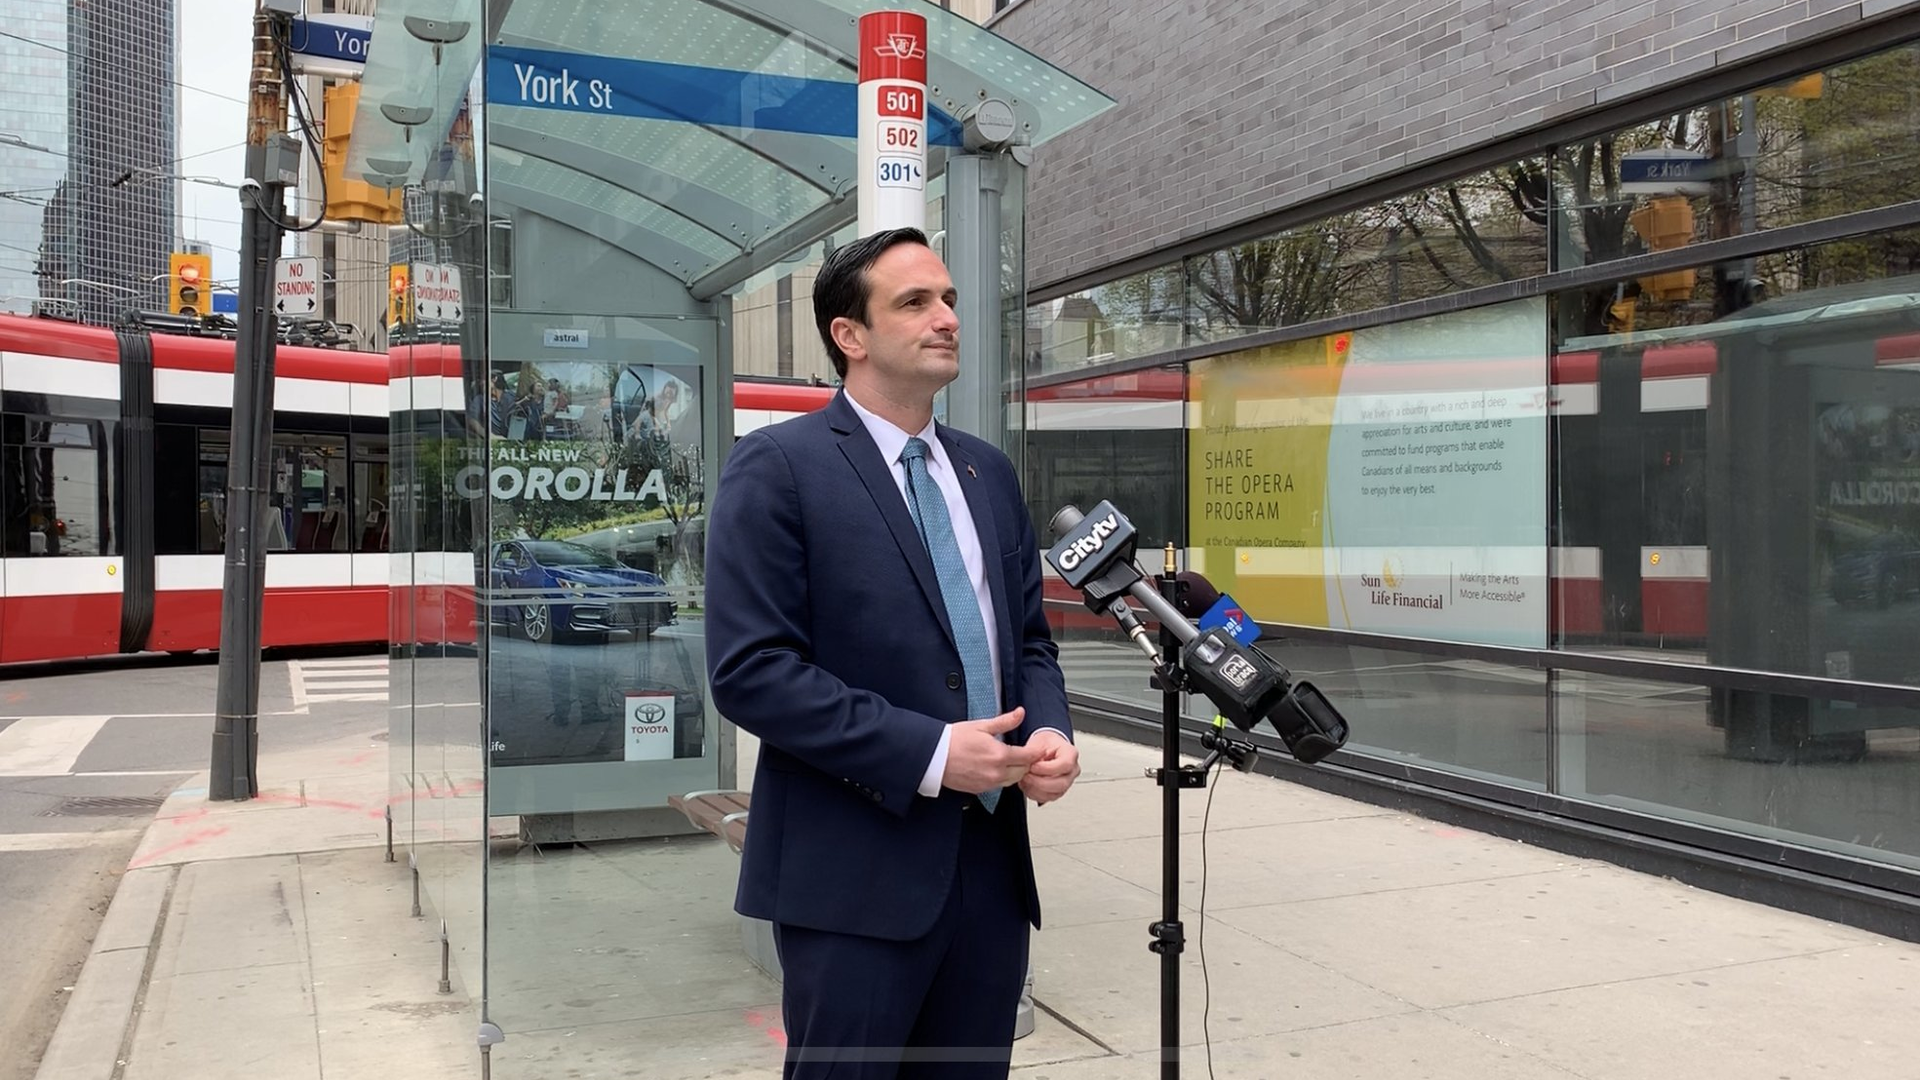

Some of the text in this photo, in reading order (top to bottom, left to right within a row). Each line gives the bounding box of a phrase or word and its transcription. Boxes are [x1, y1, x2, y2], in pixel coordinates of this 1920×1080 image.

[335, 30, 371, 56] Yor
[514, 63, 613, 109] York St
[886, 91, 918, 113] 501
[886, 127, 918, 148] 502
[880, 162, 911, 182] 301
[289, 263, 303, 277] NO
[277, 280, 315, 296] STANDING
[553, 334, 579, 342] astral
[1402, 403, 1429, 416] country
[1430, 402, 1446, 412] with
[1447, 403, 1453, 411] a
[1455, 400, 1469, 411] rich
[1471, 398, 1485, 409] and
[1487, 397, 1508, 408] deep
[1362, 427, 1400, 440] appreciation
[1402, 424, 1412, 435] for
[1414, 425, 1428, 434] arts
[1429, 422, 1444, 433] and
[1474, 419, 1489, 430] and
[456, 447, 580, 462] THE ALL-NEW
[1361, 438, 1505, 457] committed to fund programs that enable
[1205, 449, 1253, 470] SHARE
[1361, 460, 1503, 476] Canadians of all means and backgrounds
[455, 465, 668, 502] COROLLA
[1205, 473, 1294, 494] THE OPERA
[1361, 486, 1369, 495] to
[1370, 486, 1388, 497] enjoy
[1389, 484, 1401, 495] the
[1403, 486, 1418, 496] very
[1205, 501, 1279, 520] PROGRAM
[1059, 513, 1118, 570] Citytv
[1212, 536, 1223, 546] the
[1224, 536, 1252, 547] Canadian
[1254, 537, 1272, 547] Opera
[1274, 537, 1307, 547] Company
[1361, 574, 1381, 588] Sun
[1459, 573, 1520, 586] Making the Arts
[1371, 591, 1443, 609] Life Financial
[1459, 588, 1480, 599] More
[631, 725, 669, 734] TOYOTA
